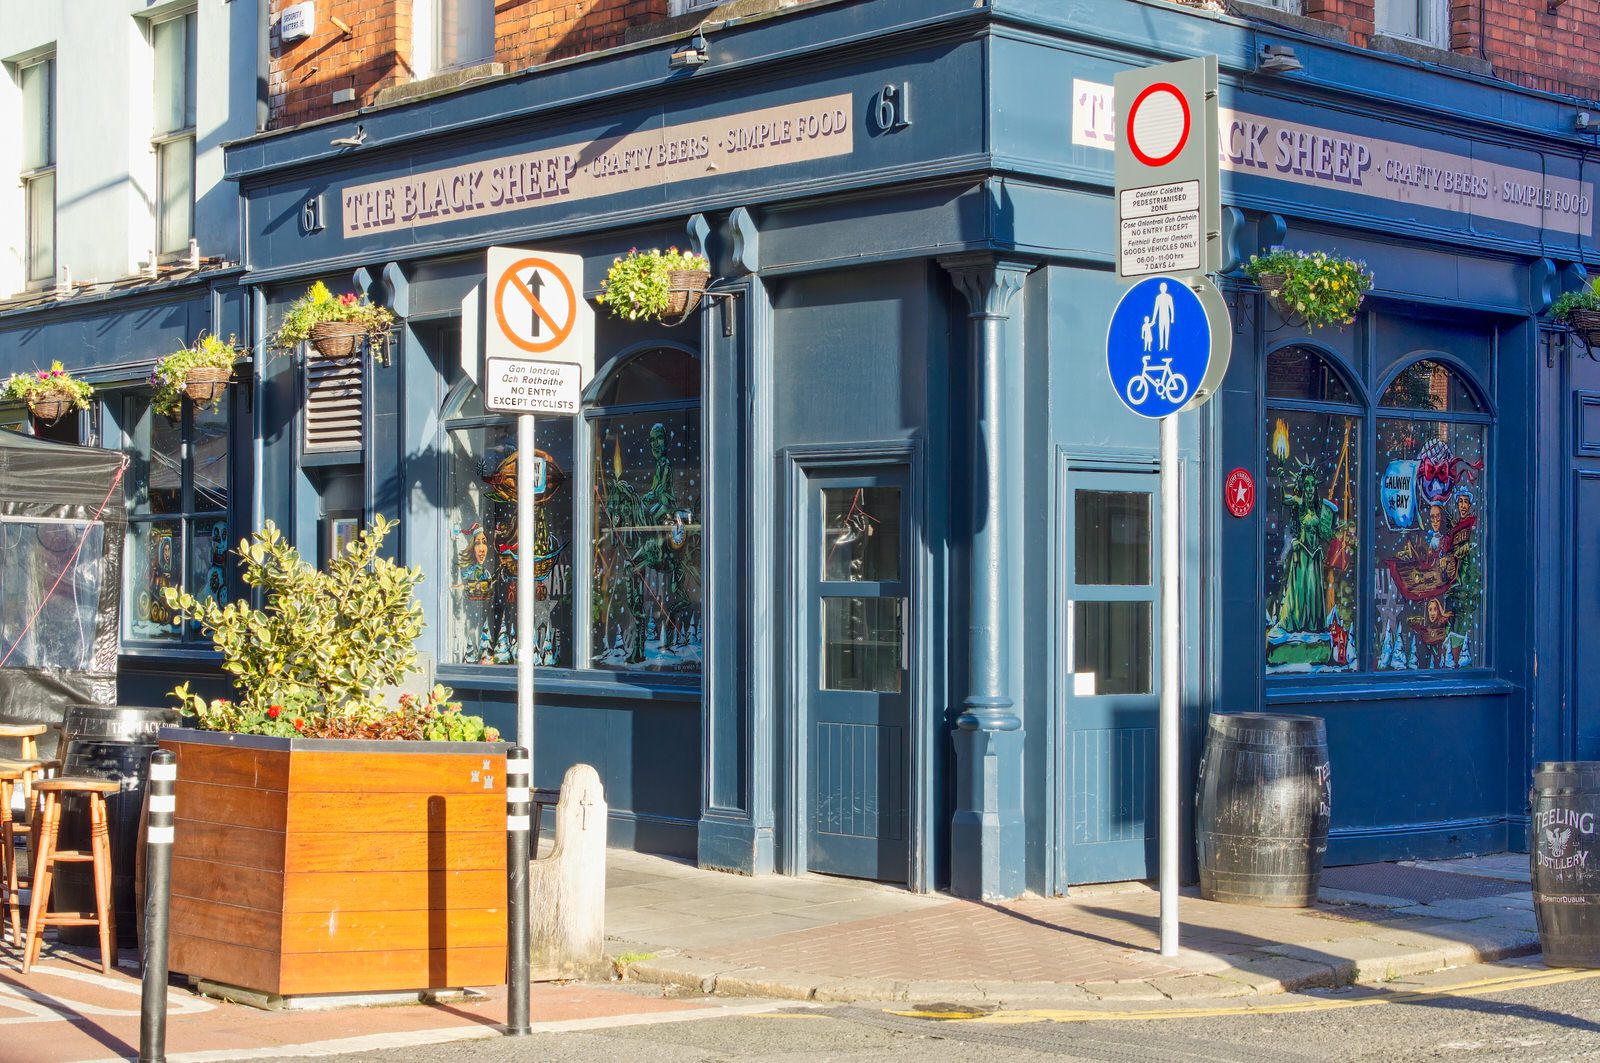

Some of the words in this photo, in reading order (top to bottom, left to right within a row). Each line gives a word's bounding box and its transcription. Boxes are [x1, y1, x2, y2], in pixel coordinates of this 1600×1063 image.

[876, 81, 912, 132] 61
[346, 186, 395, 230] THE
[400, 171, 485, 222] BLACK
[489, 154, 577, 207] SHEEP
[592, 147, 654, 178] CRAFTY
[656, 135, 709, 166] BEERS
[726, 118, 792, 153] SIMPLE
[795, 108, 847, 143] FOOD
[1276, 128, 1372, 185] SHEEP
[1385, 158, 1442, 191] CRAFTY
[1444, 168, 1488, 199] BEERS
[1503, 181, 1552, 209] SIMPLE
[1554, 189, 1590, 216] FOOD
[1132, 194, 1187, 207] PEDESTRIANISED
[301, 193, 326, 234] 61
[1151, 204, 1168, 212] ZONE
[1143, 226, 1163, 235] ENTRY
[1164, 223, 1188, 232] EXCEPT
[1124, 247, 1146, 256] GOODS
[1148, 243, 1178, 253] VEHICLES
[1180, 241, 1197, 249] ONLY
[1150, 262, 1167, 270] DAYS
[508, 364, 526, 373] Gan
[522, 376, 564, 386] Rothaithe
[511, 386, 524, 395] NO
[528, 388, 557, 397] ENTRY
[494, 396, 528, 406] EXCEPT
[530, 399, 574, 409] CYCLISTS
[1384, 476, 1411, 490] GALWAY
[1396, 495, 1410, 509] BAY
[1535, 808, 1594, 834] TEELING
[1538, 850, 1589, 870] DISTILLERY
